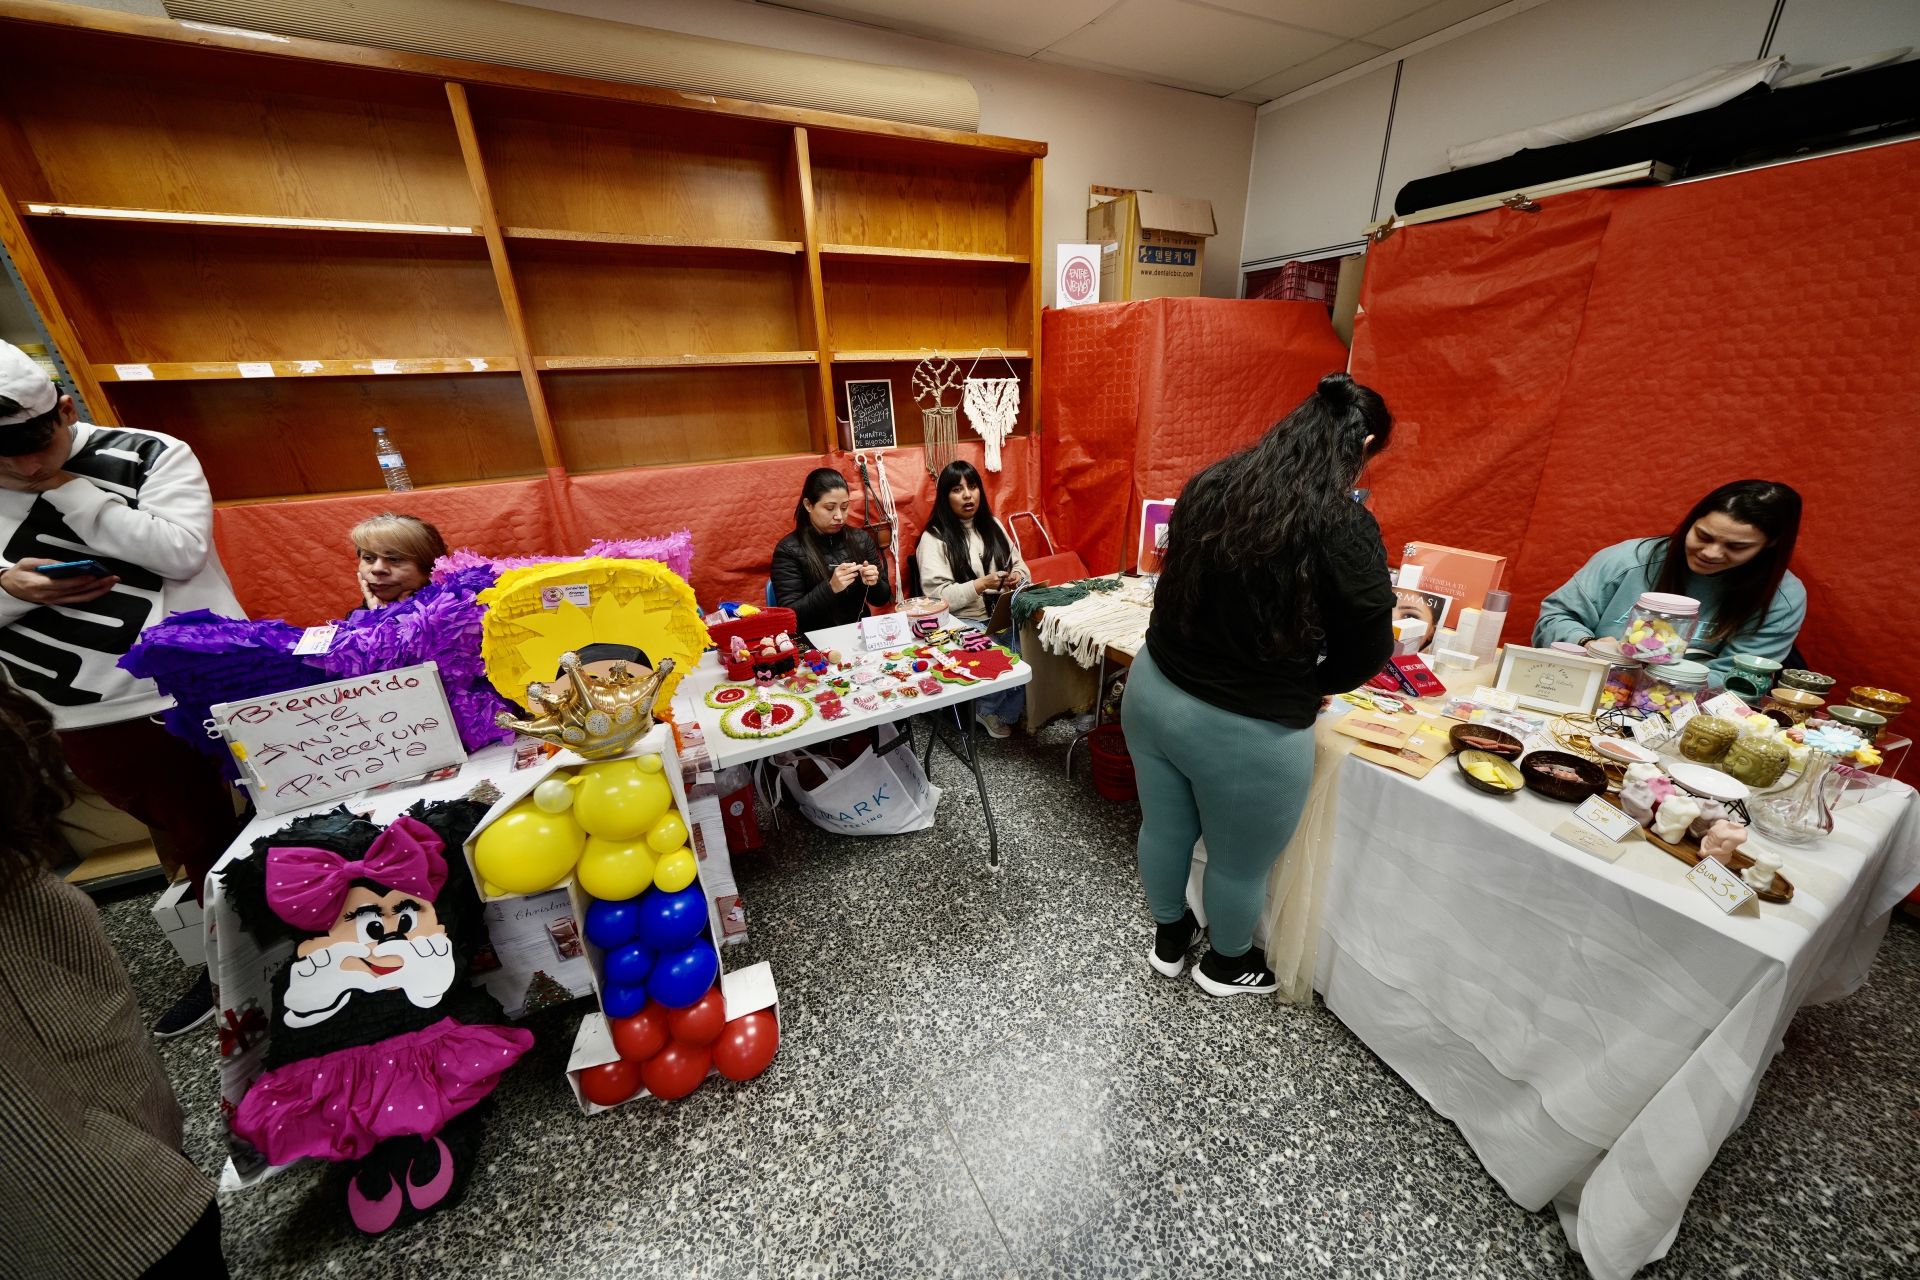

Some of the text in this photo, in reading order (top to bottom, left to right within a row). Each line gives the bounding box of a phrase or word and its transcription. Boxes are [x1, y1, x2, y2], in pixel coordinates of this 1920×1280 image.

[228, 674, 419, 725] Bienvenido
[296, 705, 358, 727] te
[392, 717, 439, 740] una
[275, 742, 427, 797] Piñata
